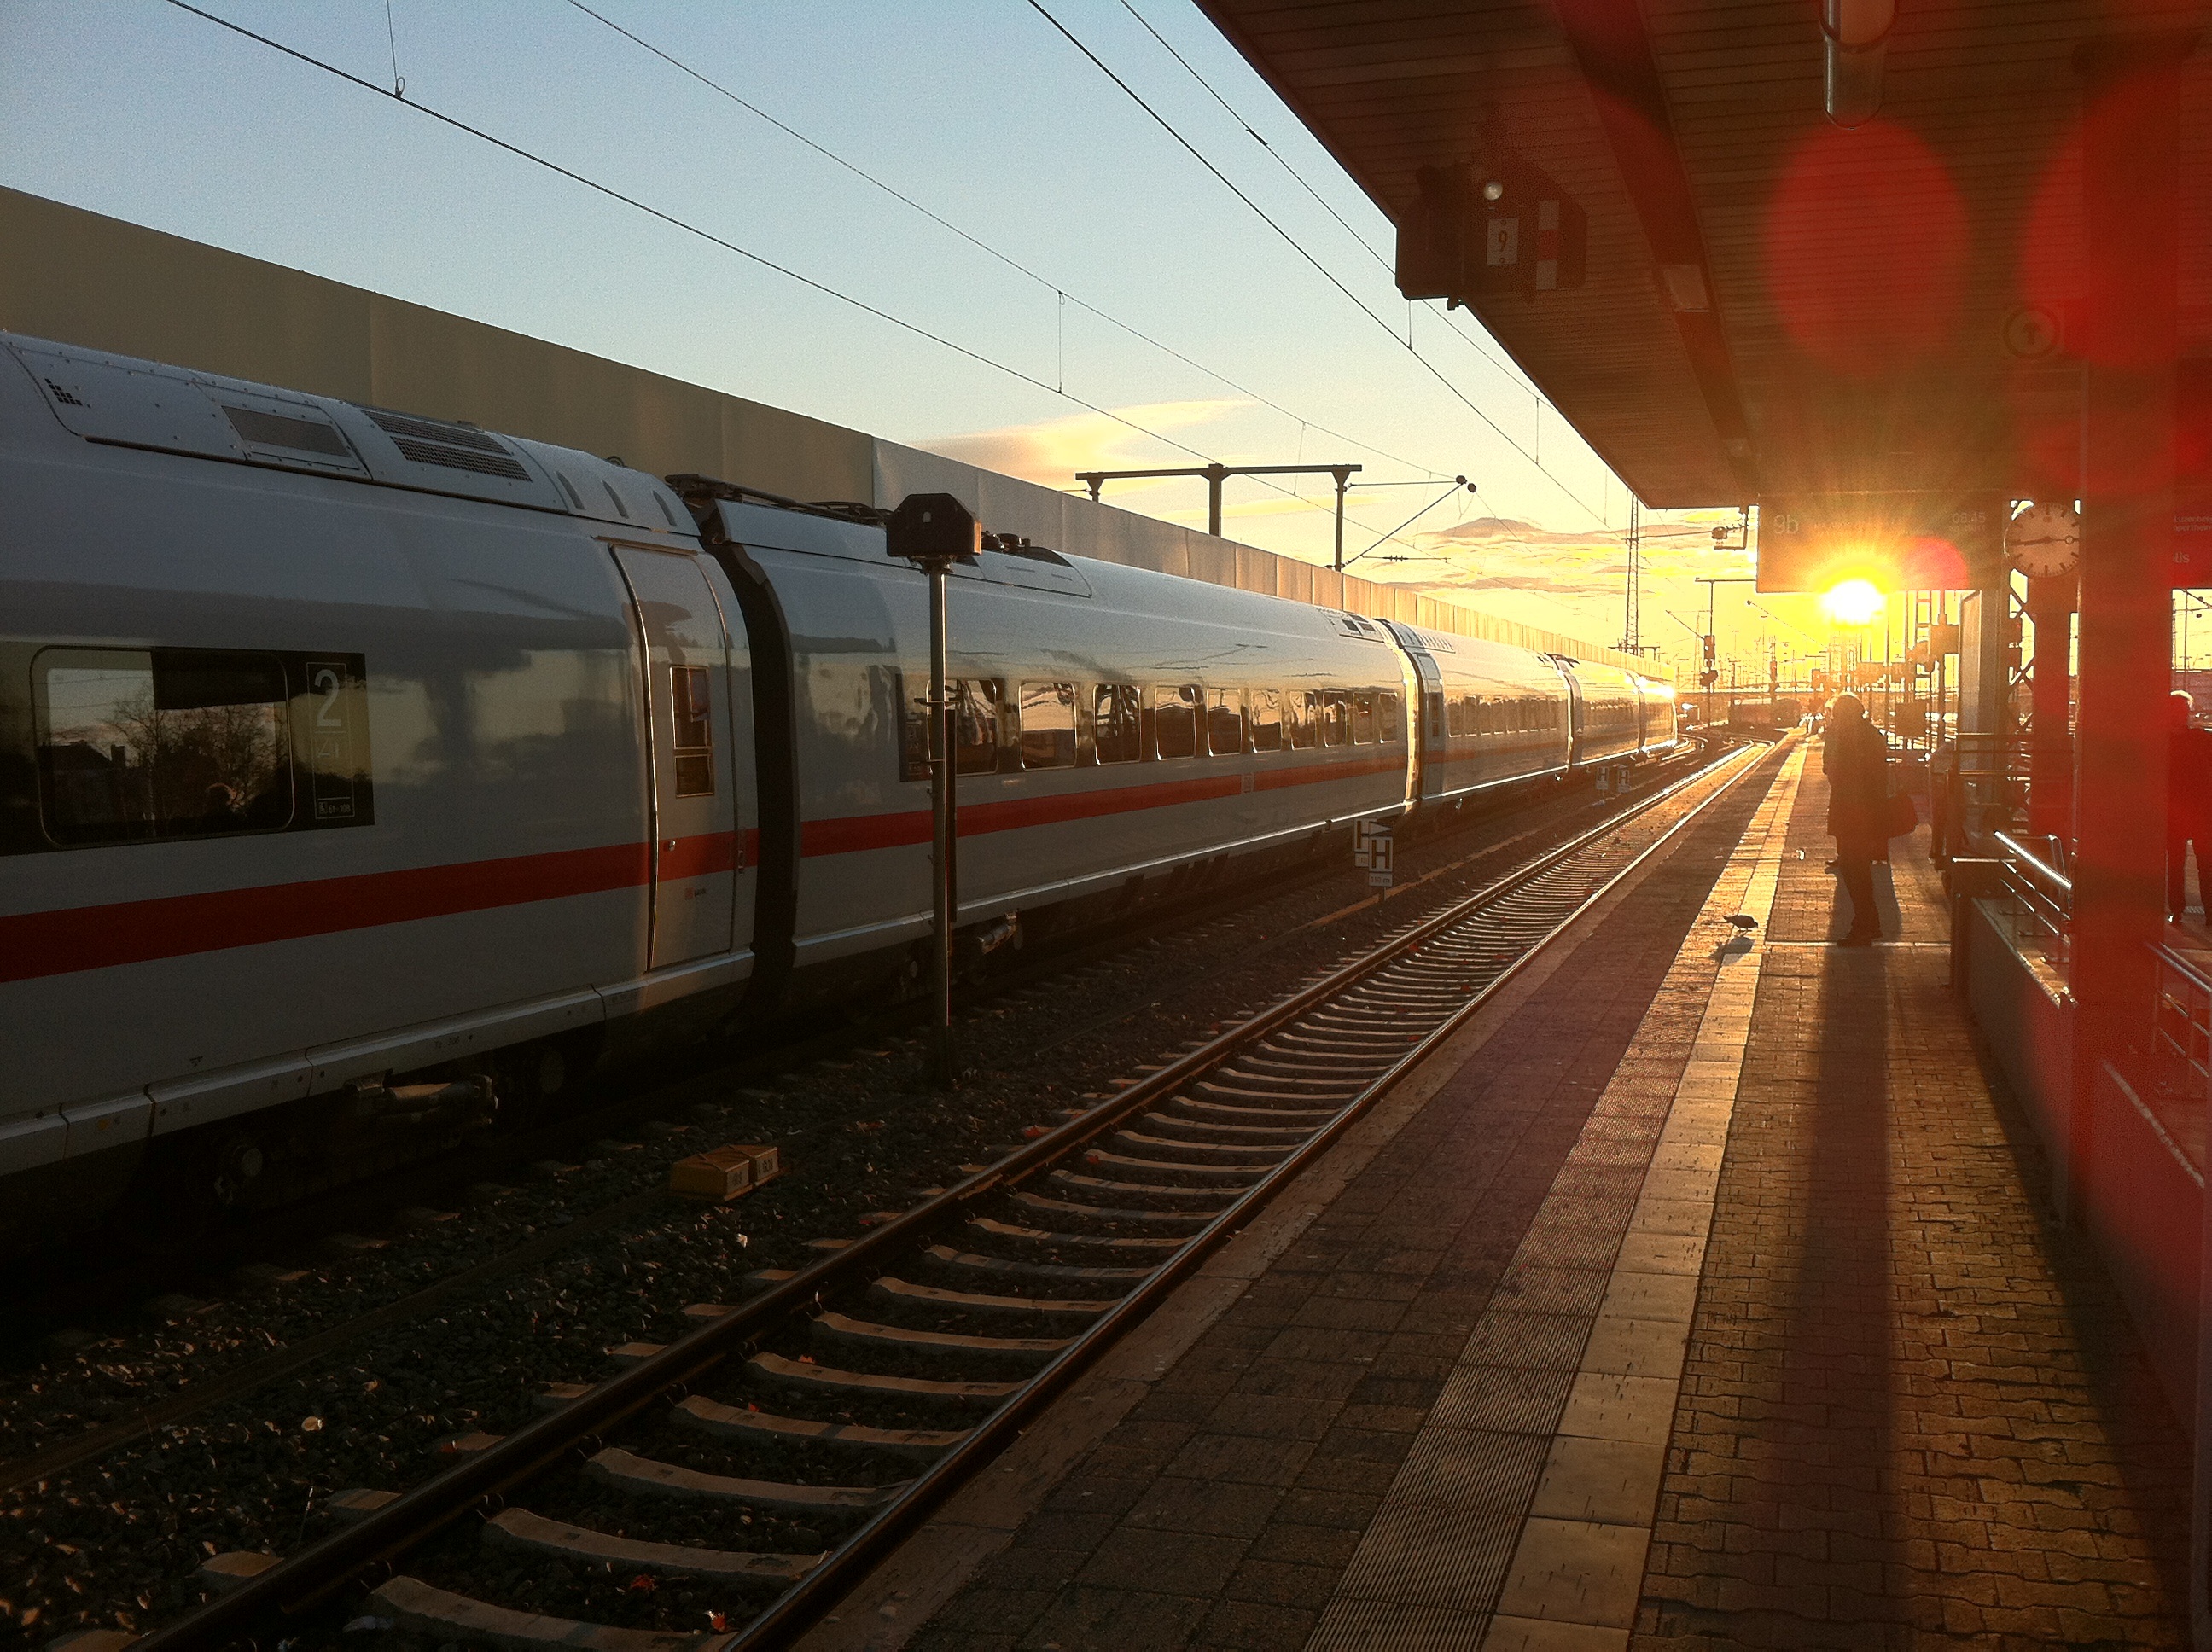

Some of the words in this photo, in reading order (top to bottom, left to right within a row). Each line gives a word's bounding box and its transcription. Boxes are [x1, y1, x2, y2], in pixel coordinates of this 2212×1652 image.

[1499, 229, 1508, 252] 9
[1774, 514, 1799, 535] 9b
[314, 668, 341, 727] 2
[1371, 840, 1390, 869] H
